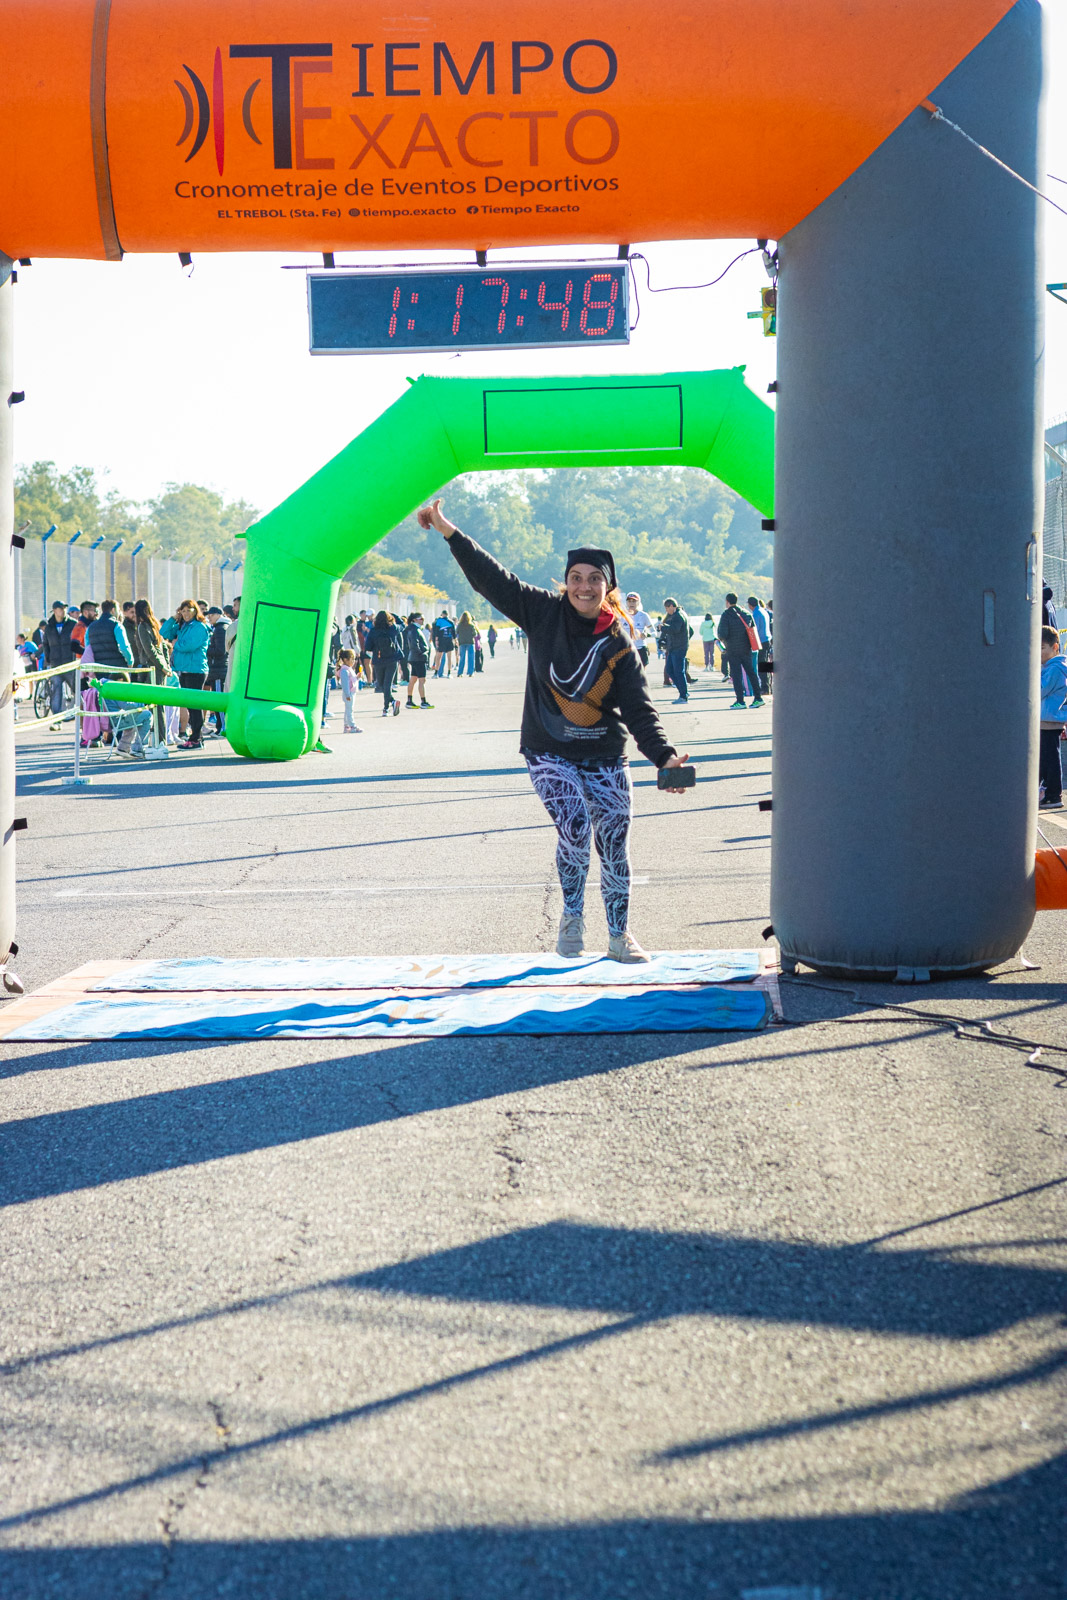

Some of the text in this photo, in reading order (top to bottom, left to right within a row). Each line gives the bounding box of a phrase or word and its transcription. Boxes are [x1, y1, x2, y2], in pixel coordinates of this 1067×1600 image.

[174, 174, 619, 201] Cronometraje de Eventos Deportivos
[217, 208, 342, 219] EL TREBOL (Sta. Fe)
[481, 204, 581, 216] Tiempo Exacto
